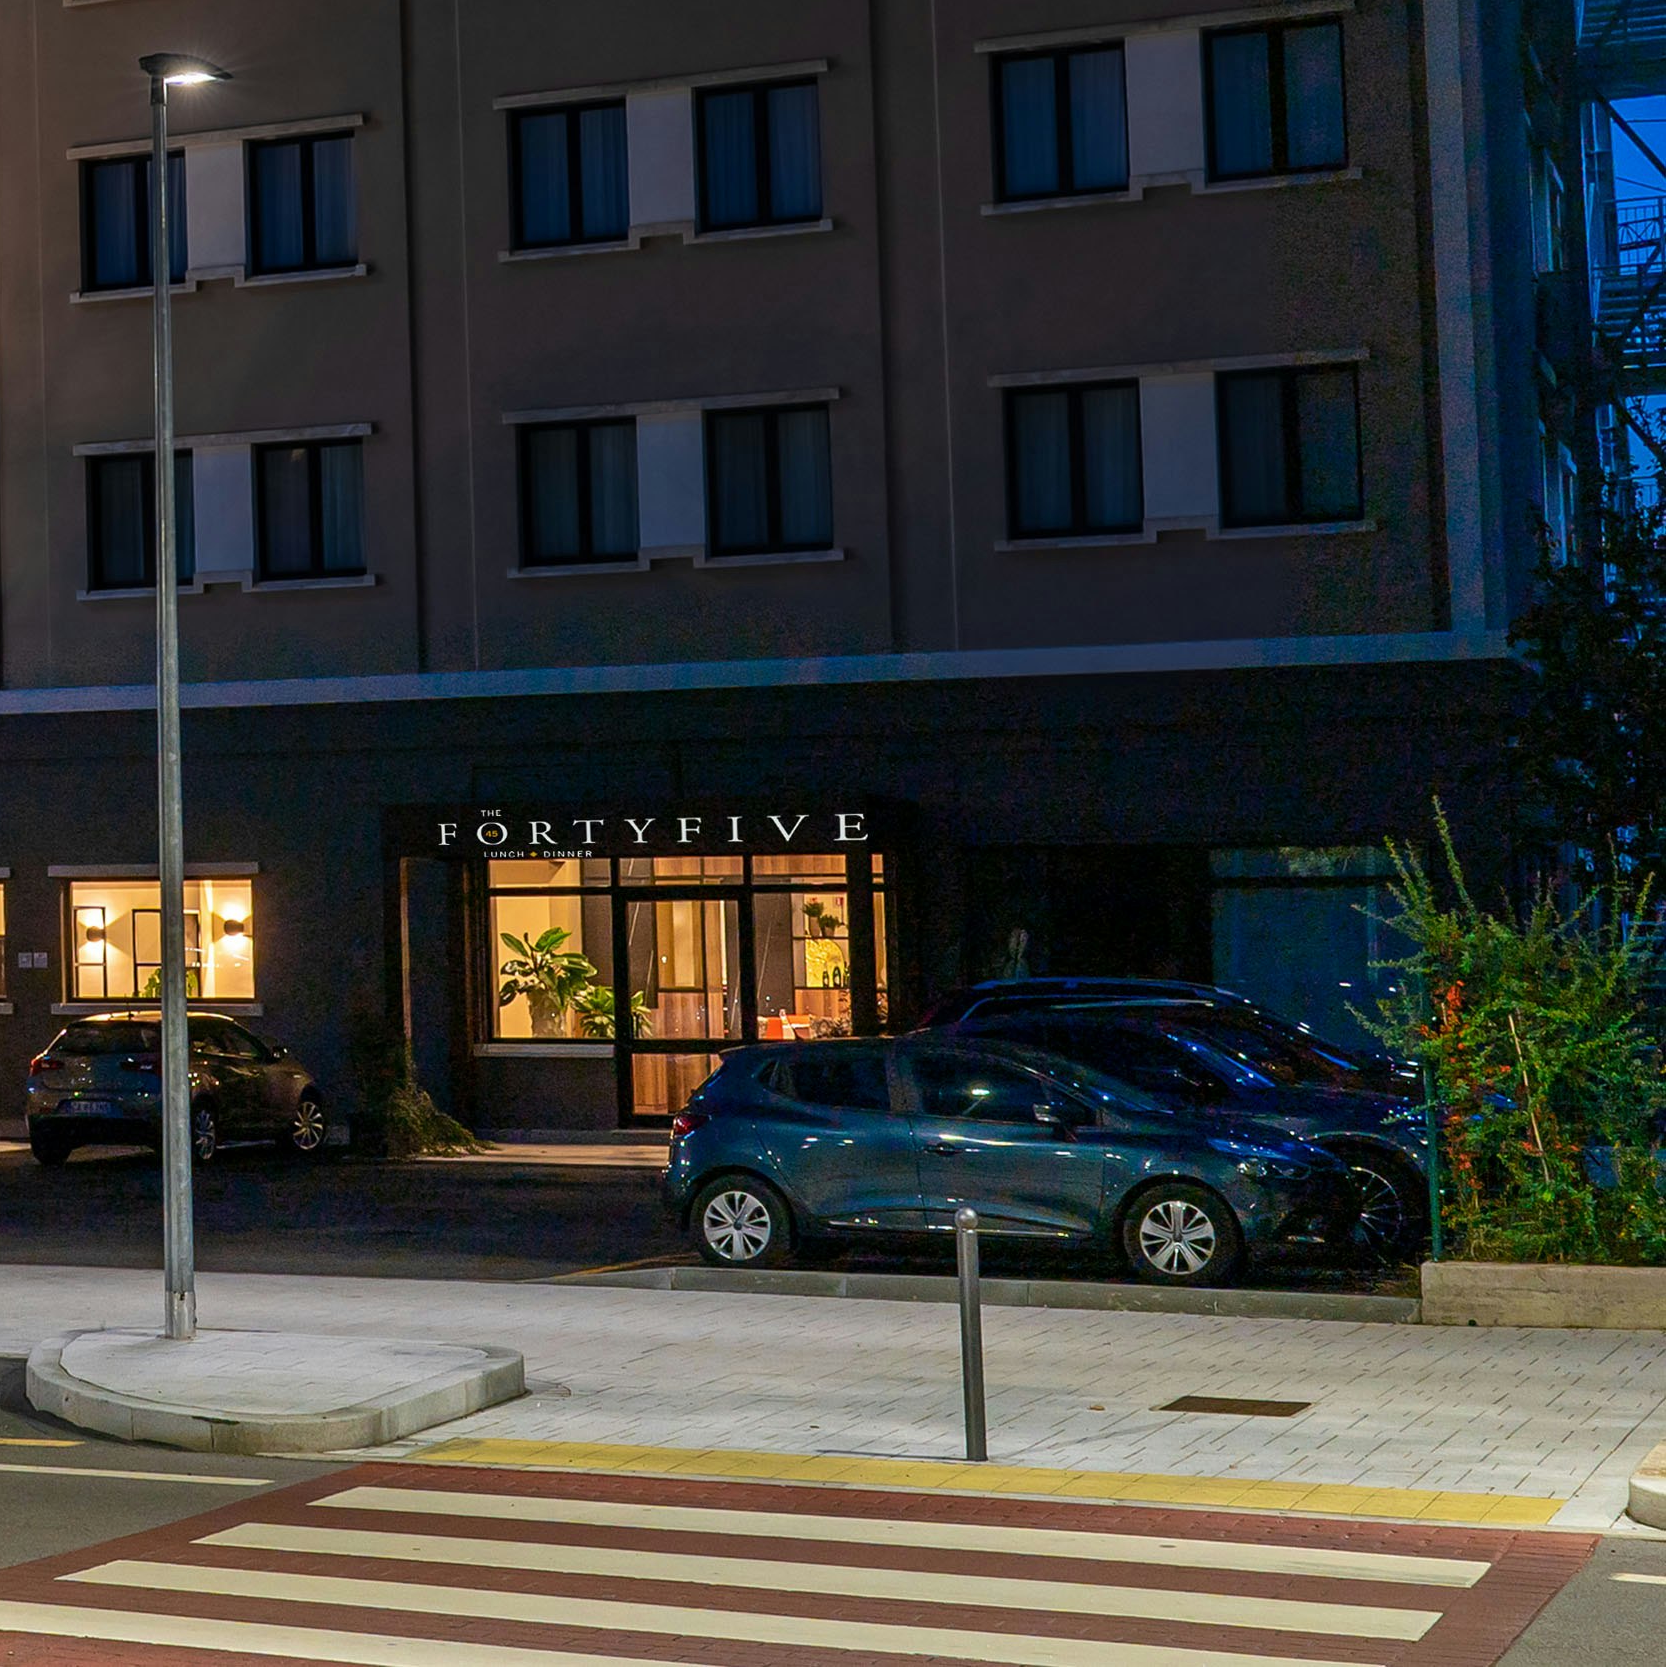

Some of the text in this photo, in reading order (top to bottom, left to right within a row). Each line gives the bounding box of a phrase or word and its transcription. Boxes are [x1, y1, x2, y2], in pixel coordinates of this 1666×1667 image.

[480, 809, 502, 817] THE
[437, 813, 869, 846] FORTYFIVE
[483, 850, 593, 858] LUNCH DINNER
